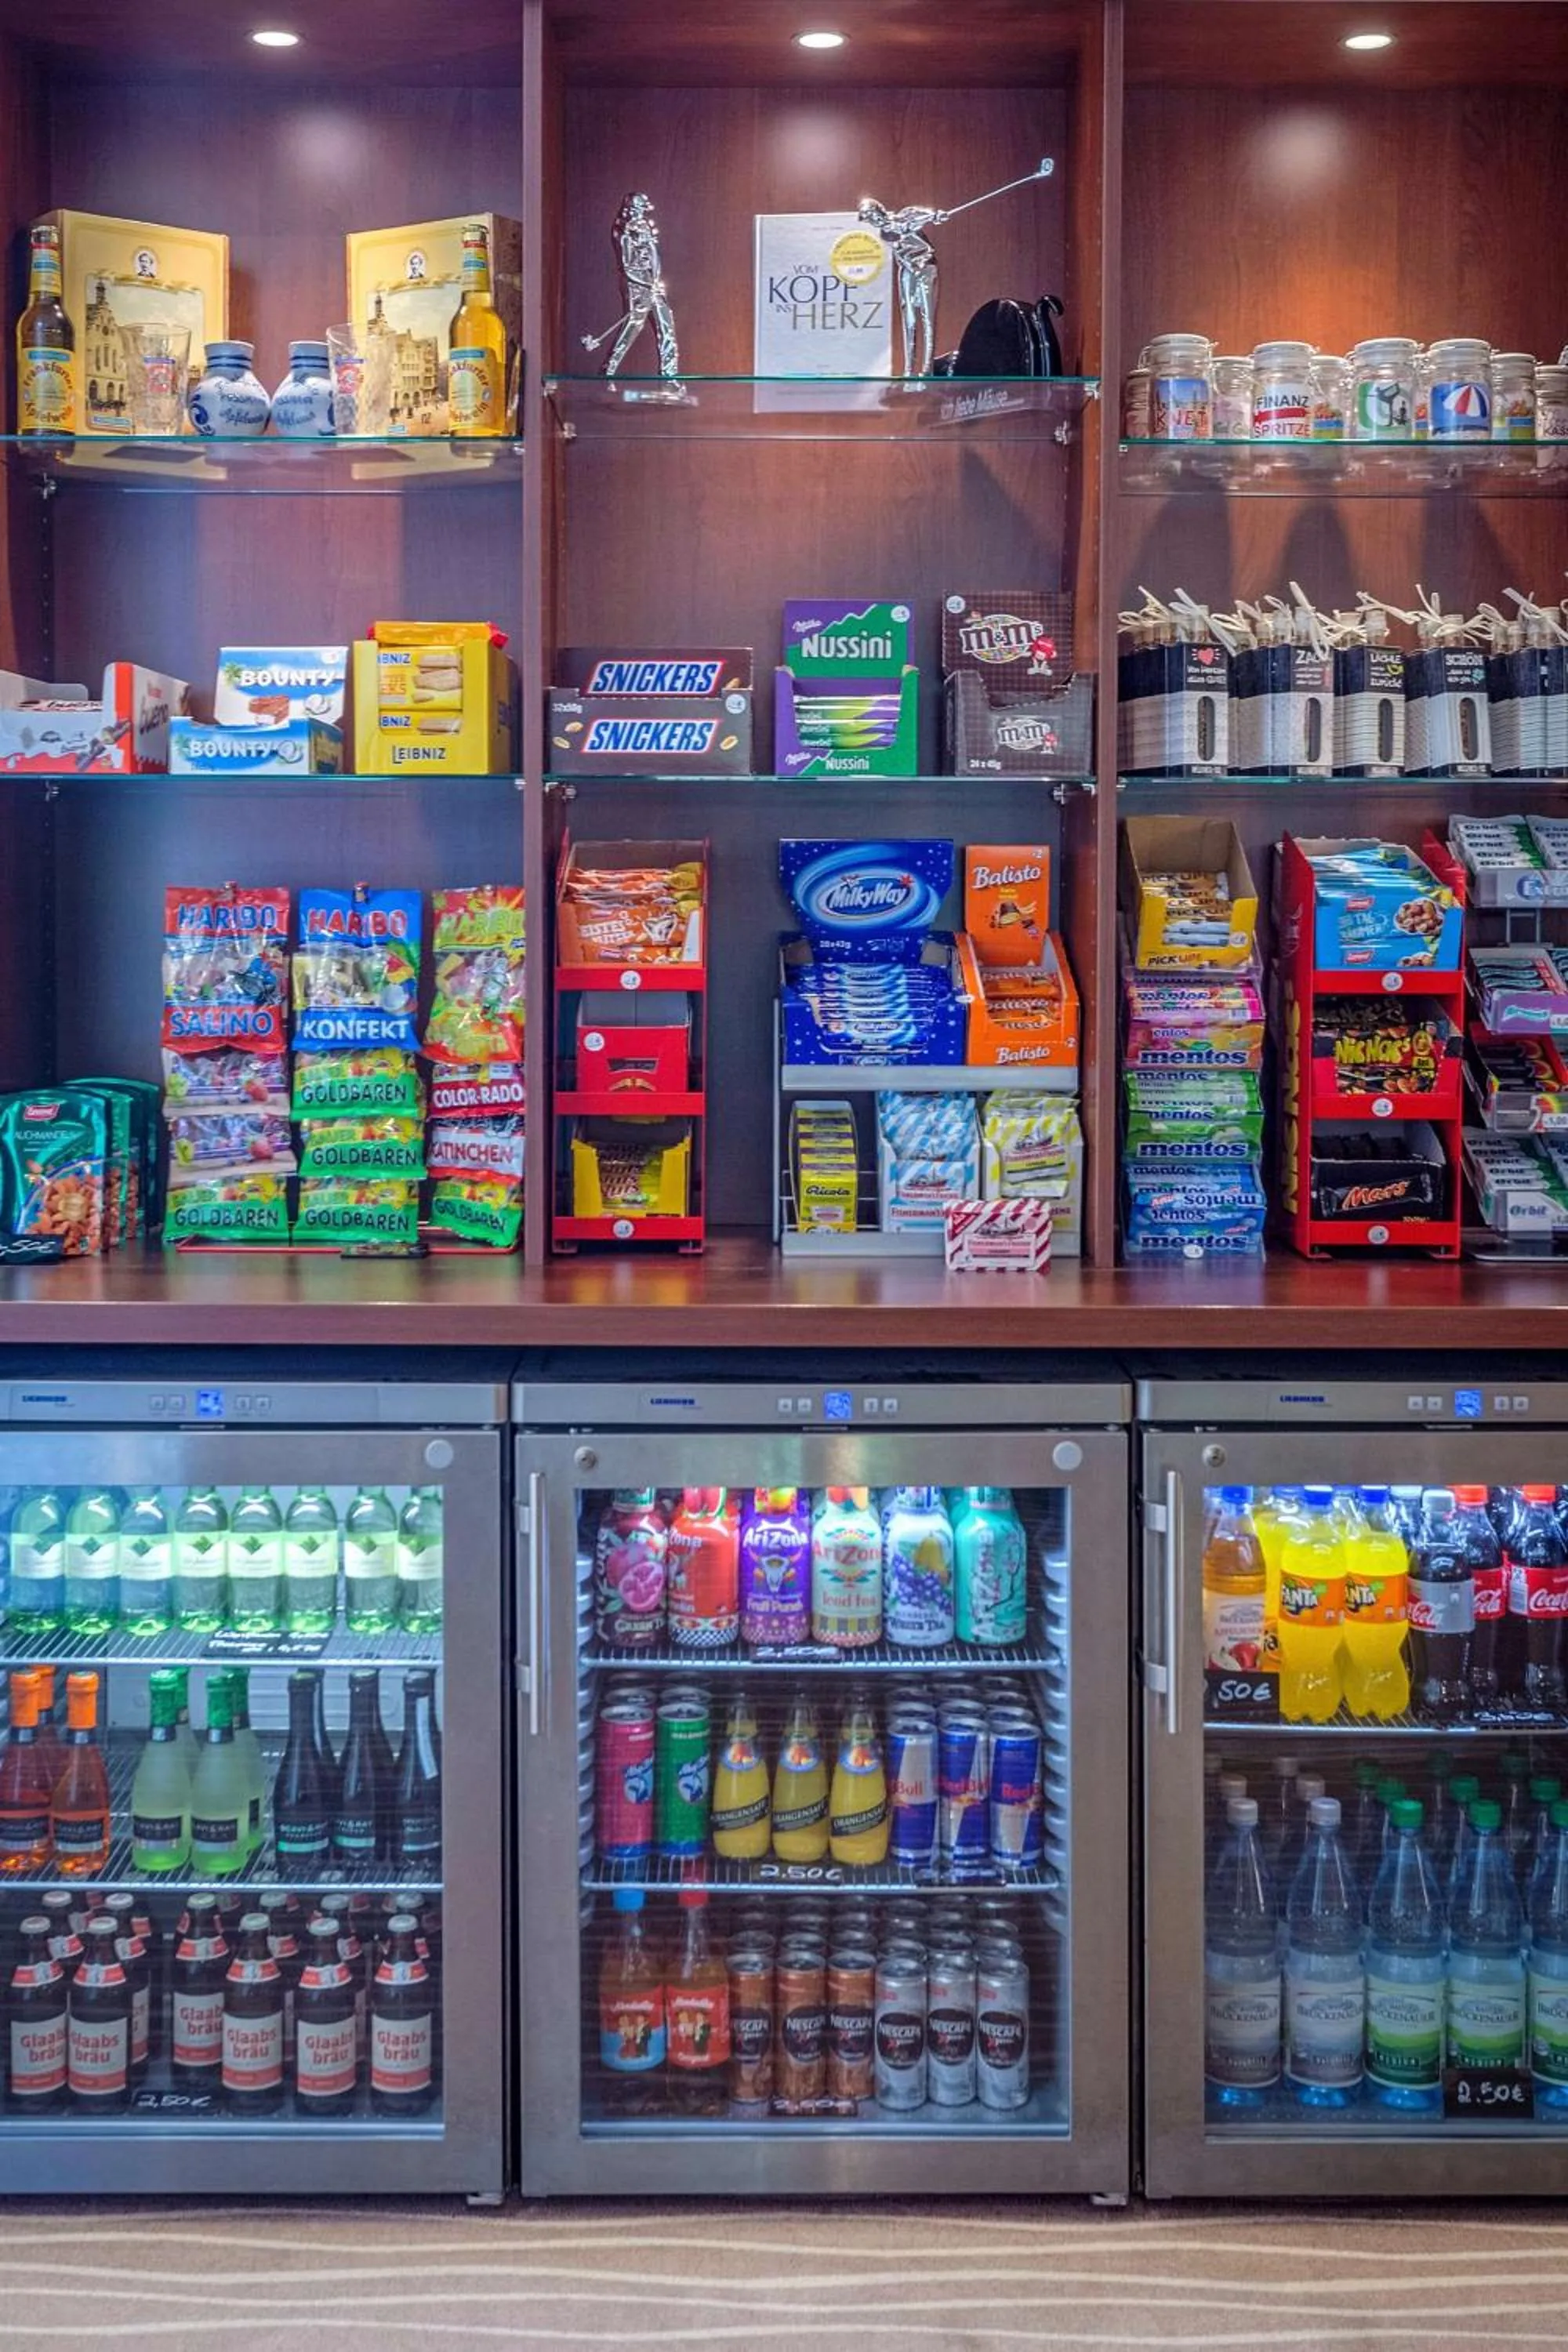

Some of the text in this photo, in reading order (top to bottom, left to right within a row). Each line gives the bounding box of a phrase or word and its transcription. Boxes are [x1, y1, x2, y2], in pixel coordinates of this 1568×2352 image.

[768, 275, 858, 303] KOPF
[793, 302, 884, 330] HERZ
[1256, 394, 1308, 408] FINANZ
[1254, 423, 1312, 438] SPRITZE
[801, 631, 892, 659] Nussini
[238, 668, 336, 687] BOUNTY
[593, 662, 719, 692] SNICKERS
[588, 721, 715, 750] SNICKERS
[189, 740, 270, 759] BOUNTY
[393, 746, 447, 765] LEIBNIZ
[825, 755, 870, 771] Nussini
[972, 865, 1041, 889] Balisto
[178, 903, 277, 930] HARIBO
[308, 909, 408, 937] HARIBO
[171, 1011, 273, 1037] SALINO
[303, 1018, 409, 1040] KONFEKT
[996, 1046, 1051, 1065] Balisto
[1139, 1050, 1248, 1065] mentos
[434, 1083, 524, 1109] COLOR-RADO
[1139, 1142, 1248, 1157] mentos
[805, 1185, 851, 1196] Ricola
[1341, 1180, 1410, 1210] Mars
[1140, 1236, 1248, 1250] mentos
[232, 2044, 269, 2060] bräu
[313, 2047, 350, 2065] bräu
[383, 2045, 420, 2061] bräu
